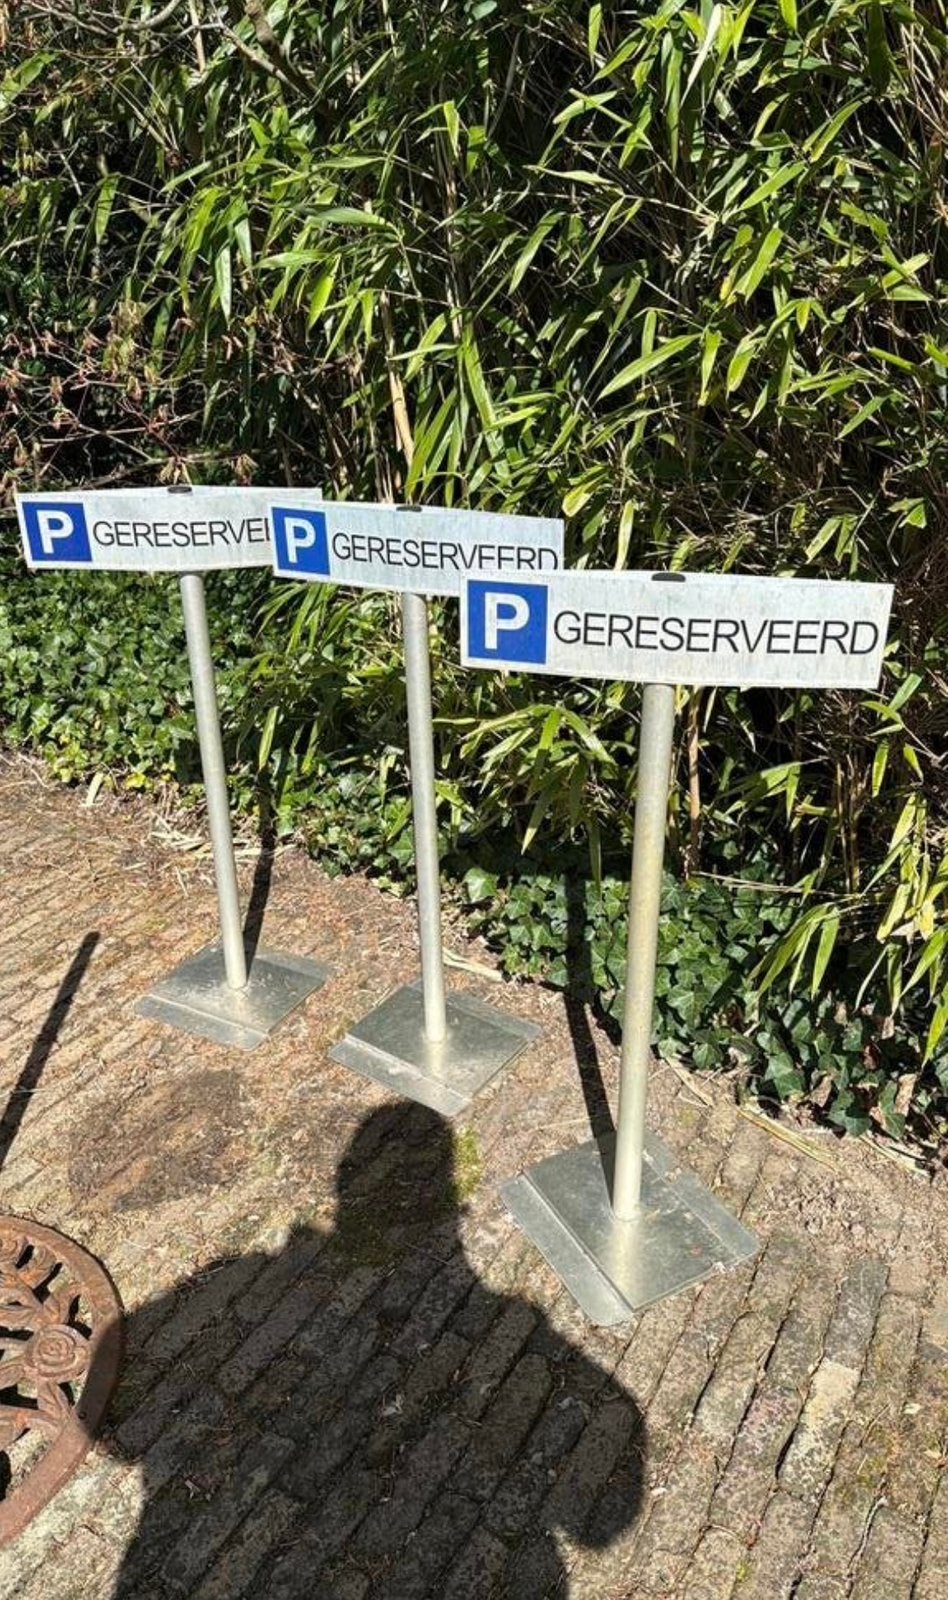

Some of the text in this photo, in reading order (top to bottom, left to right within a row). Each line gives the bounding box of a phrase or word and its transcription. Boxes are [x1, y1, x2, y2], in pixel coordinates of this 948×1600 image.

[36, 509, 271, 554] P GERESERVE
[283, 517, 559, 571] P GERESERVEERD
[484, 591, 880, 656] P GERESERVEERD
